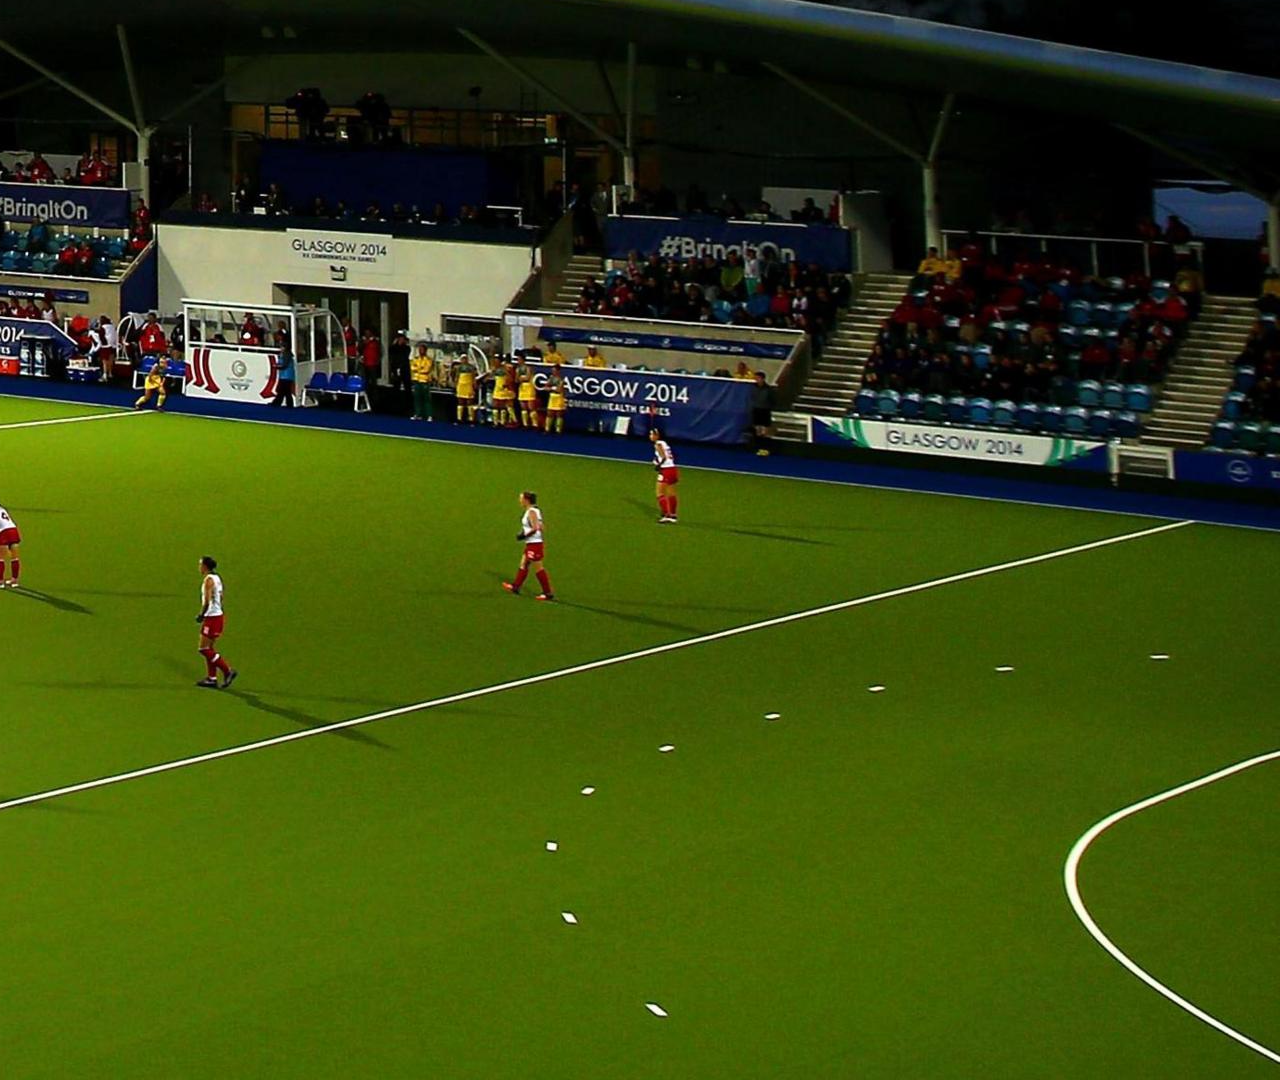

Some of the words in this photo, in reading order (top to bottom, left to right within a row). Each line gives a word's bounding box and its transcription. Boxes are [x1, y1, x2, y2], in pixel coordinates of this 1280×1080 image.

[292, 239, 356, 254] GLASGOW
[360, 243, 387, 256] 2014
[533, 373, 638, 399] GASGOW
[644, 382, 690, 404] 2014
[887, 430, 979, 454] GLASGOW
[986, 438, 1024, 456] 2014
